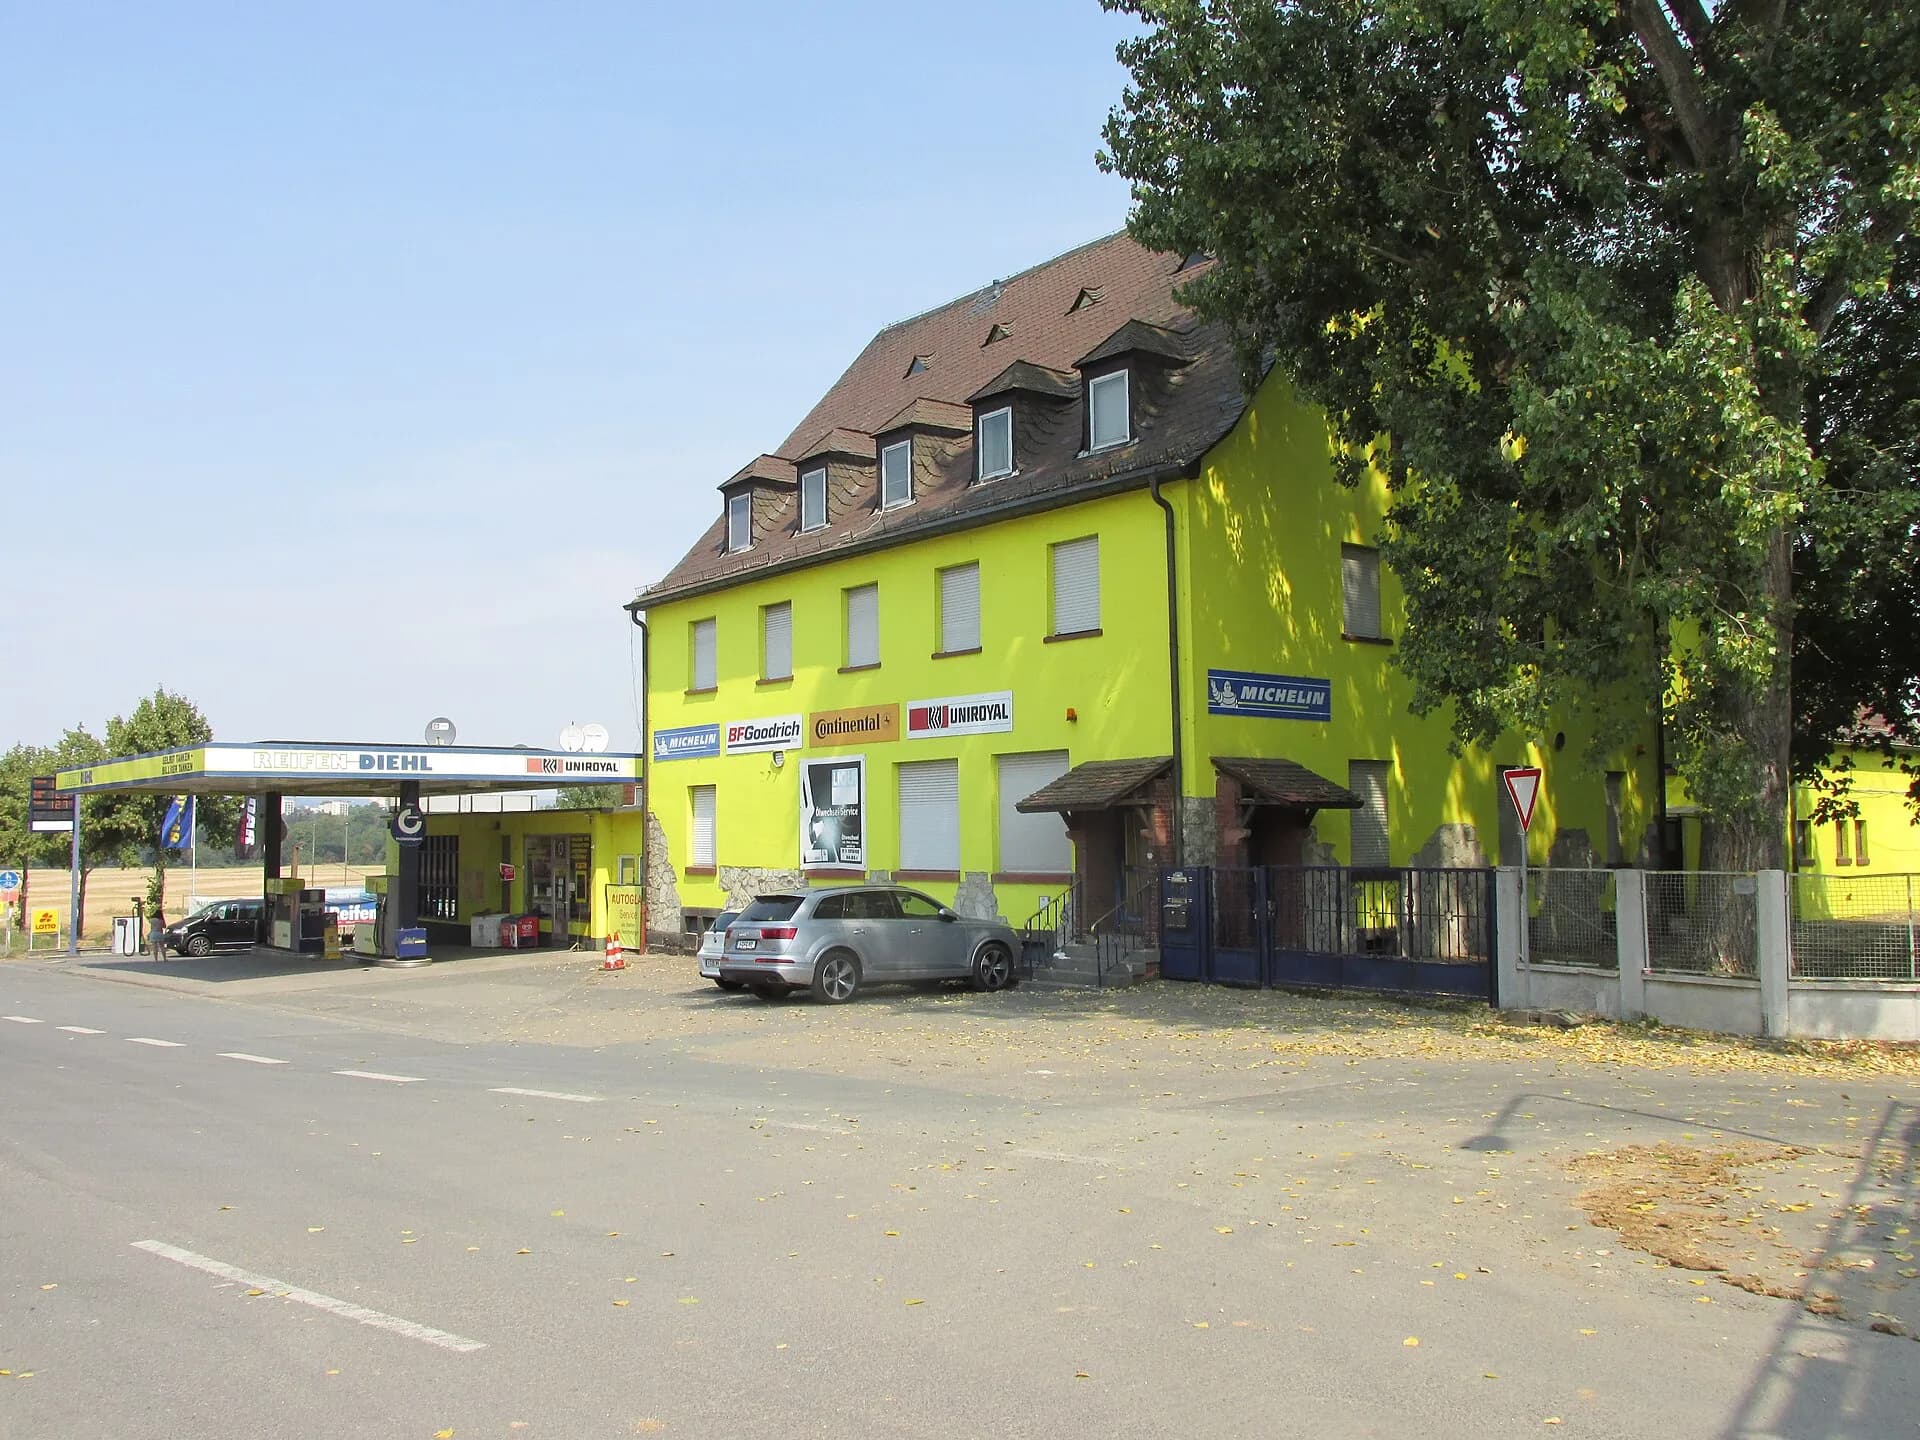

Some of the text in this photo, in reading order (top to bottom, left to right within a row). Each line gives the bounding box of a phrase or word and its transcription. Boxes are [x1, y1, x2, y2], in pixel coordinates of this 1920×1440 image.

[1240, 685, 1325, 705] MICHELIN
[950, 702, 1008, 723] UNIROYAL
[727, 720, 800, 743] BFGoodrich
[815, 713, 880, 739] Continental
[669, 733, 716, 749] MICHELIN
[253, 751, 433, 771] REIFEN DIEHL
[565, 761, 619, 772] UNIROYAL
